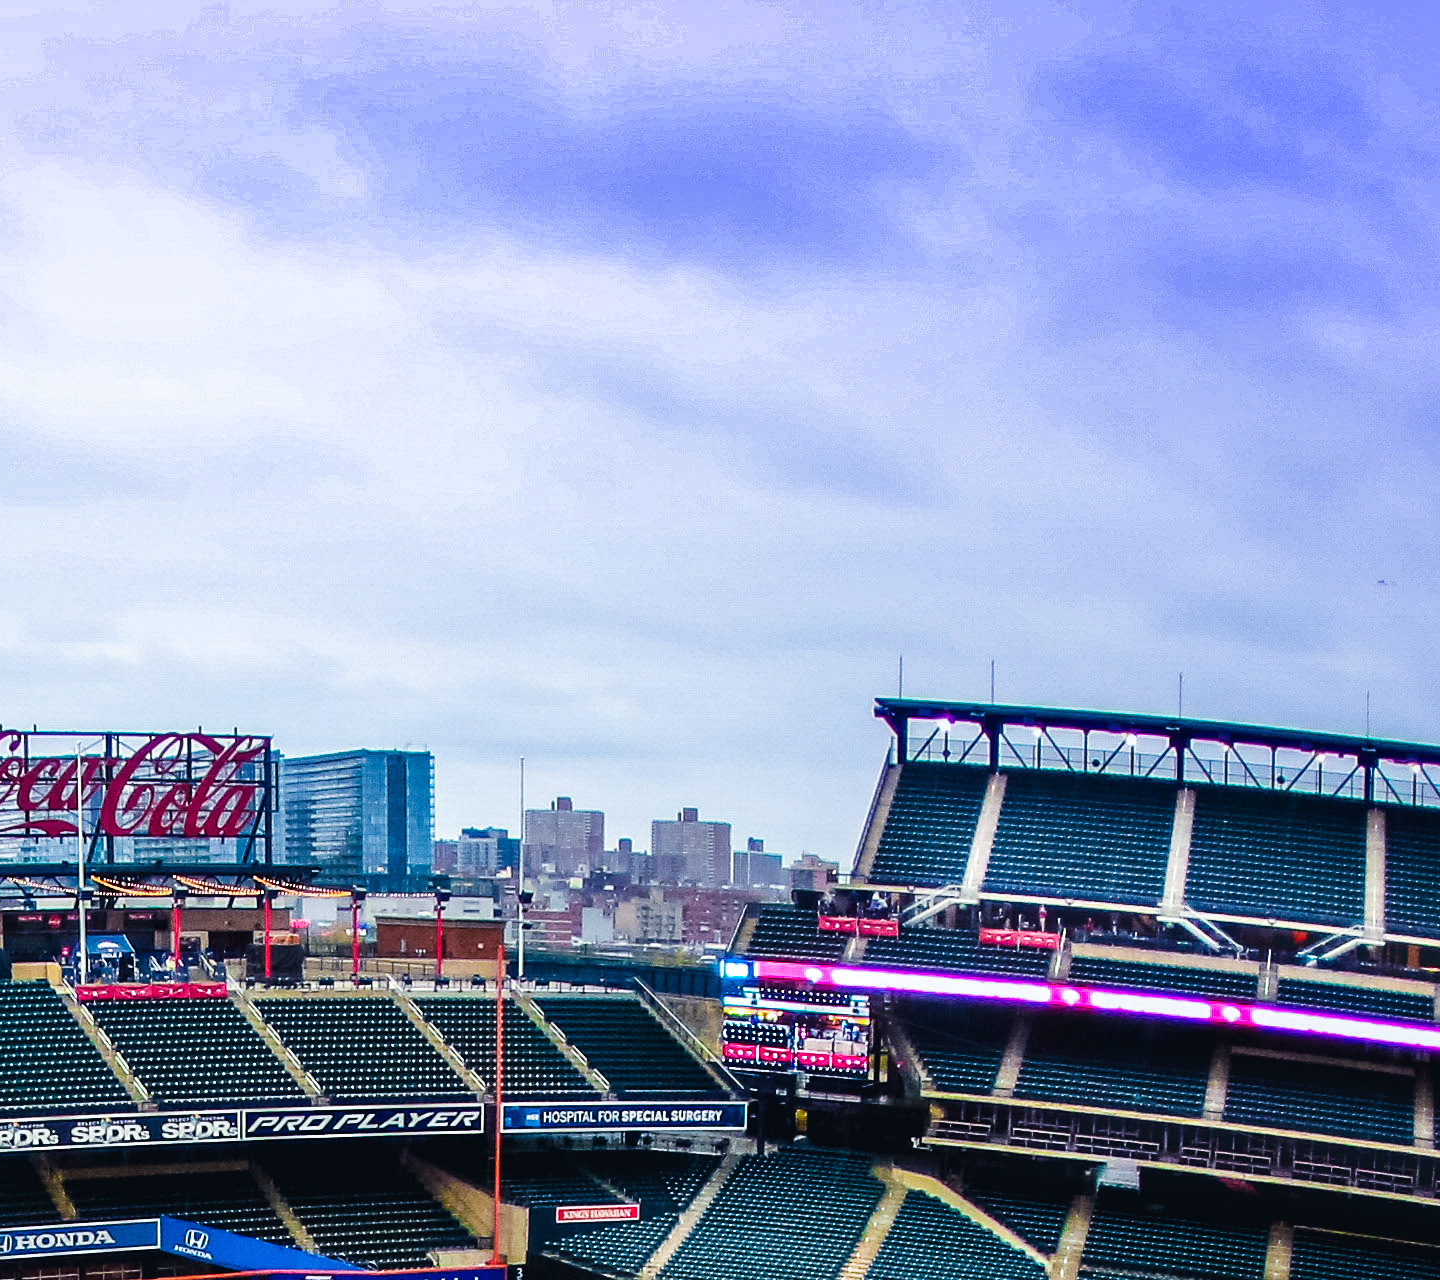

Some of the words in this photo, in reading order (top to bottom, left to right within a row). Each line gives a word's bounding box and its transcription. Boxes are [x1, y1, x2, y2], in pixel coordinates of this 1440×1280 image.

[246, 1113, 326, 1134] PRO
[334, 1109, 479, 1132] PLAYER
[543, 1110, 597, 1123] HOSPITAL
[597, 1111, 620, 1123] FOR
[621, 1110, 670, 1122] SPECIAL
[670, 1109, 723, 1122] SURGERY
[14, 1229, 116, 1251] HONDA
[173, 1244, 213, 1261] HONDA
